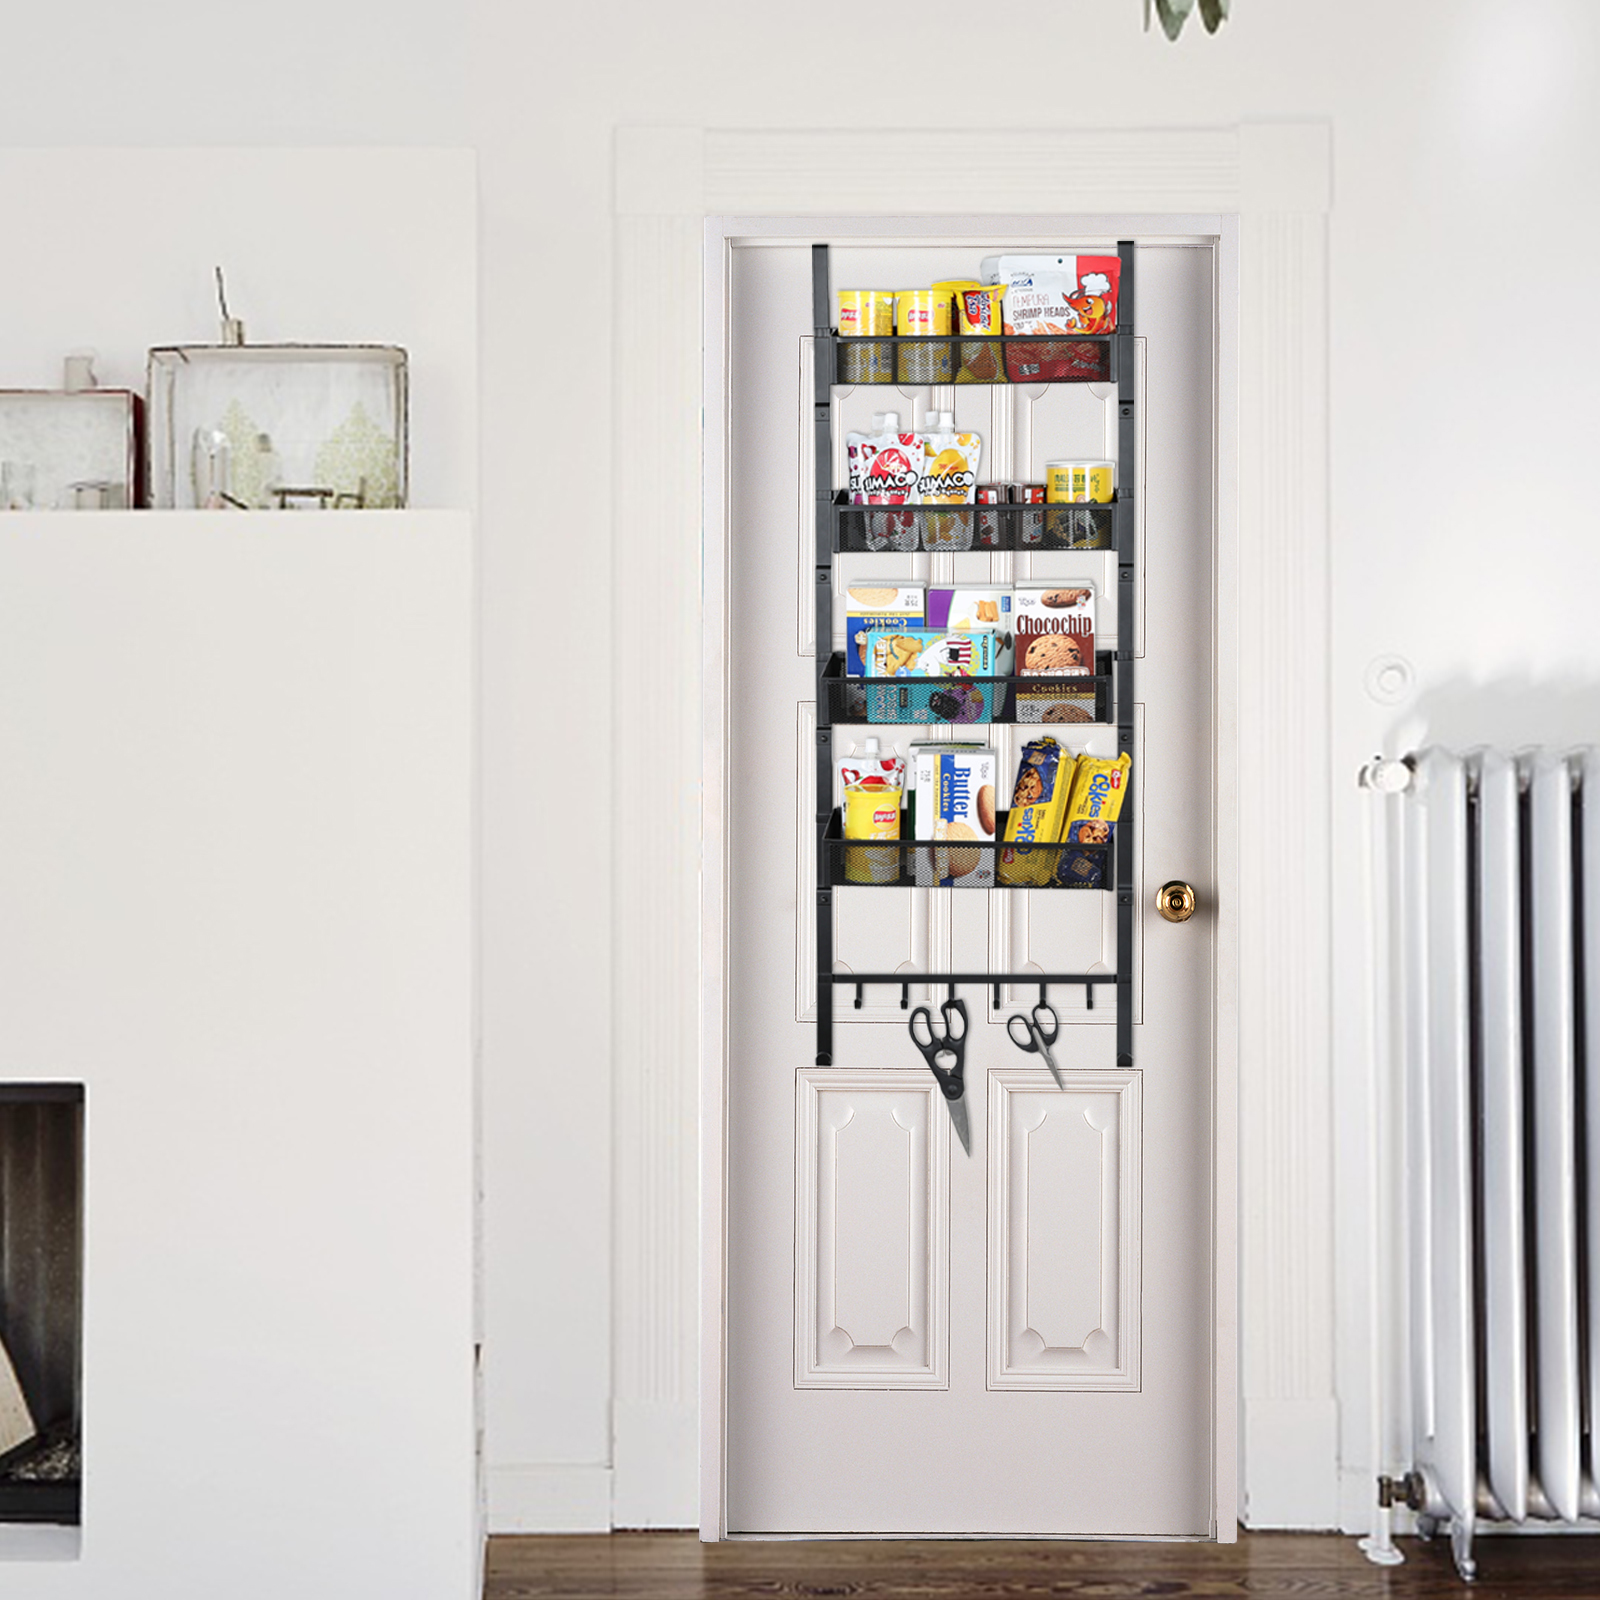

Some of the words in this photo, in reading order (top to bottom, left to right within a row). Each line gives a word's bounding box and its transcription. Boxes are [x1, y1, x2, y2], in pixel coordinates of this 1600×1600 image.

[1012, 307, 1042, 321] SHRIMP
[1043, 306, 1071, 317] HEADS
[863, 617, 908, 627] Cookies
[1016, 613, 1092, 637] Chocochip
[1032, 683, 1078, 693] Cookies
[942, 773, 951, 812] Cookies
[953, 767, 971, 818] Butter
[1088, 773, 1111, 818] Cookies
